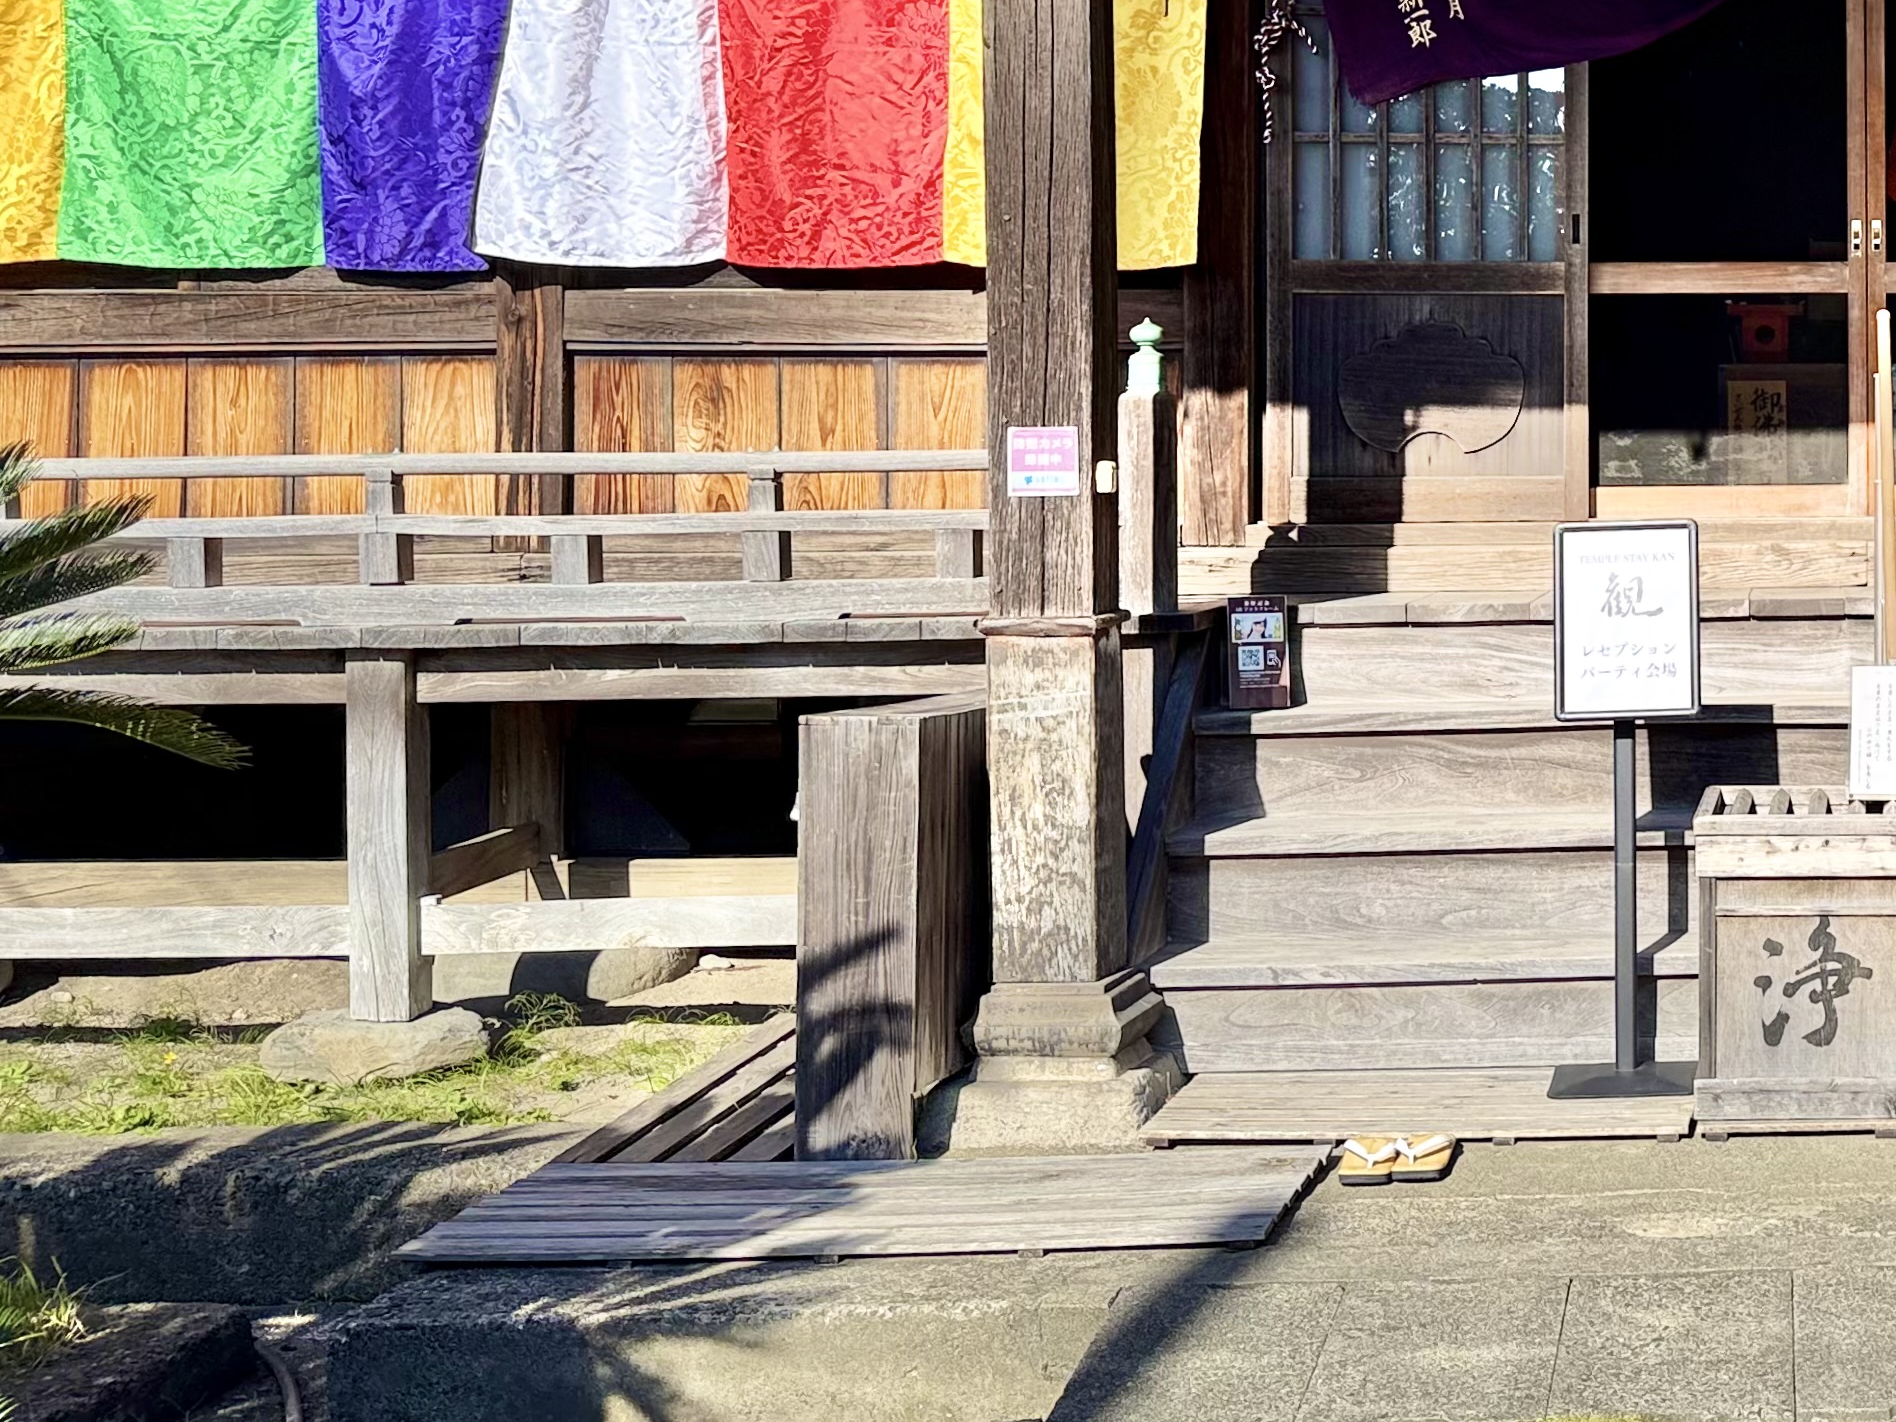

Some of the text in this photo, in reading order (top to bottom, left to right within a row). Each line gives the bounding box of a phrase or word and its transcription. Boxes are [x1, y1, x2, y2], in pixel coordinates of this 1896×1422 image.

[1579, 552, 1676, 565] TEMPLE STAY KAN
[1600, 572, 1665, 618] 観
[1583, 641, 1677, 658] レセプション
[1580, 662, 1678, 679] パーティ会場
